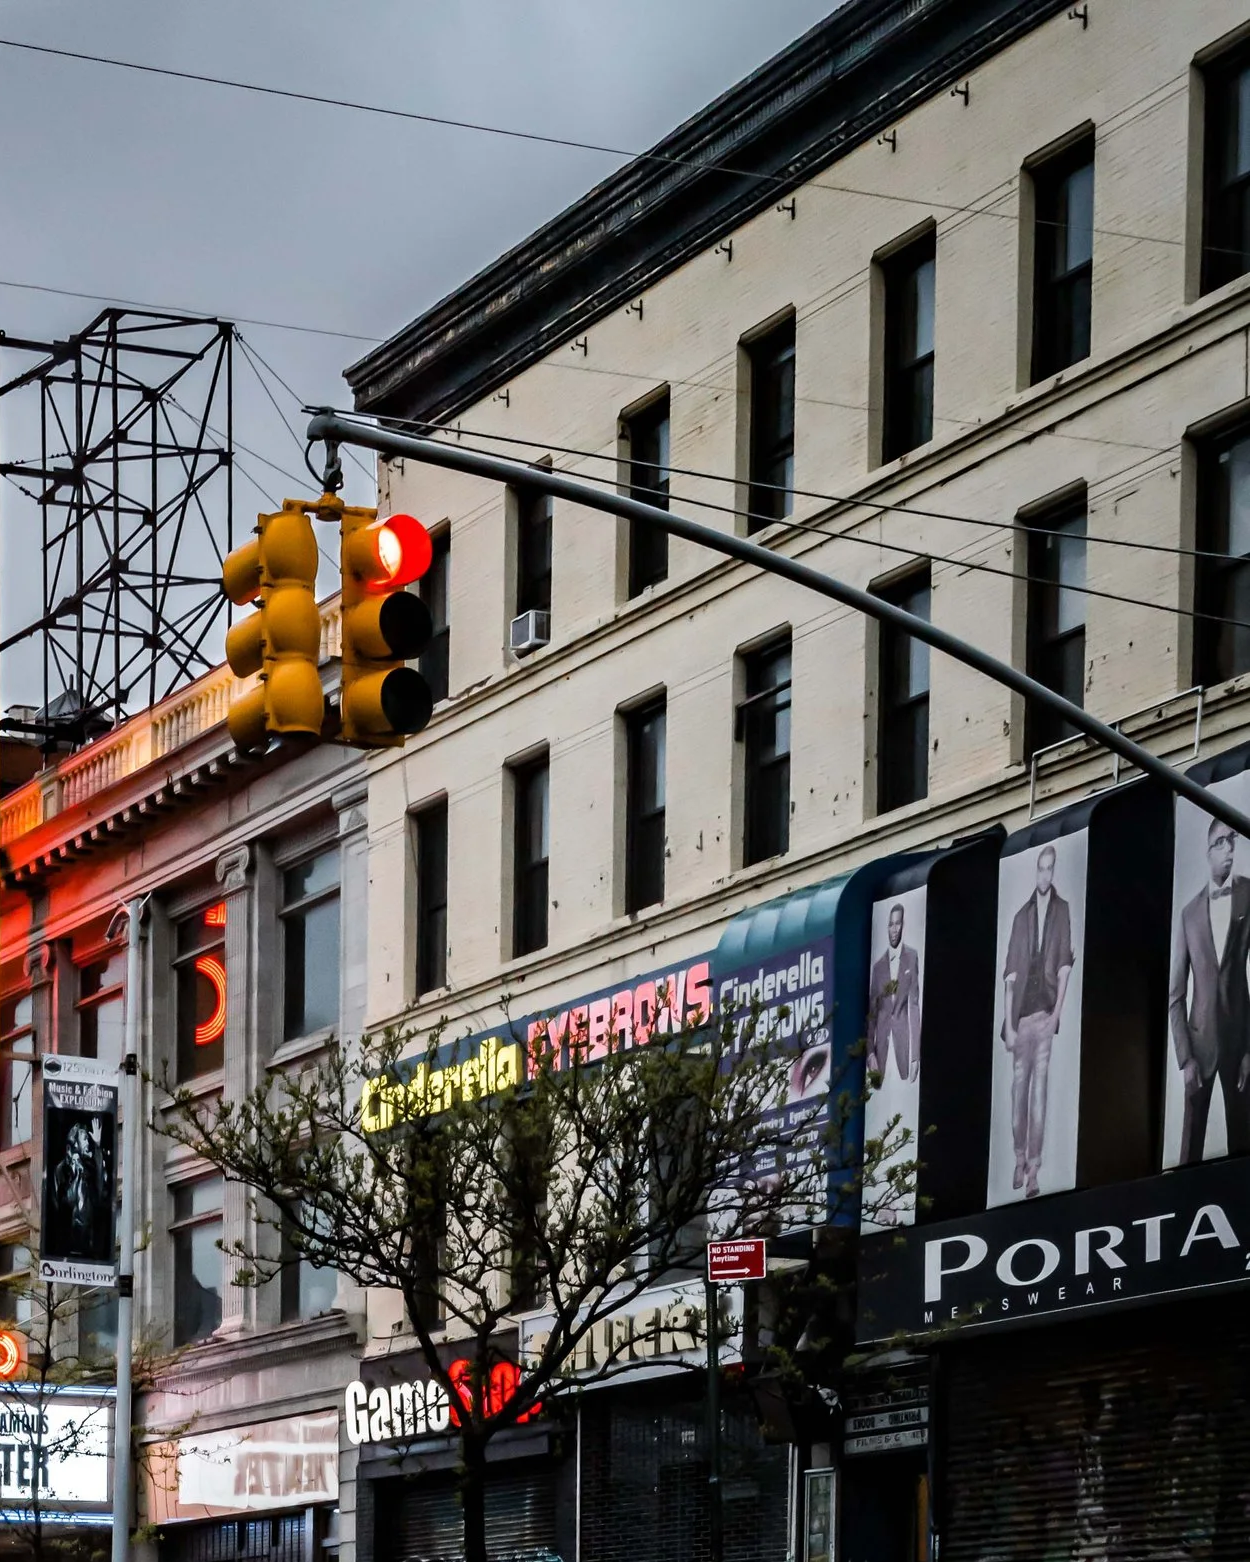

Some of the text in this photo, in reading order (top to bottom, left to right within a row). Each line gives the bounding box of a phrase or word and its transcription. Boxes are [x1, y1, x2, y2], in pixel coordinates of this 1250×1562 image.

[719, 951, 825, 1016] Cinderella
[720, 990, 825, 1058] YBROWS
[361, 961, 712, 1133] Cinderella EYEBROWS
[49, 1082, 113, 1099] Music & Fashion
[59, 1093, 103, 1107] EXPLOSION
[712, 1254, 740, 1264] Anytime
[723, 1244, 756, 1254] STANDING
[924, 1203, 1241, 1303] PORTA
[42, 1261, 111, 1284] Burlington
